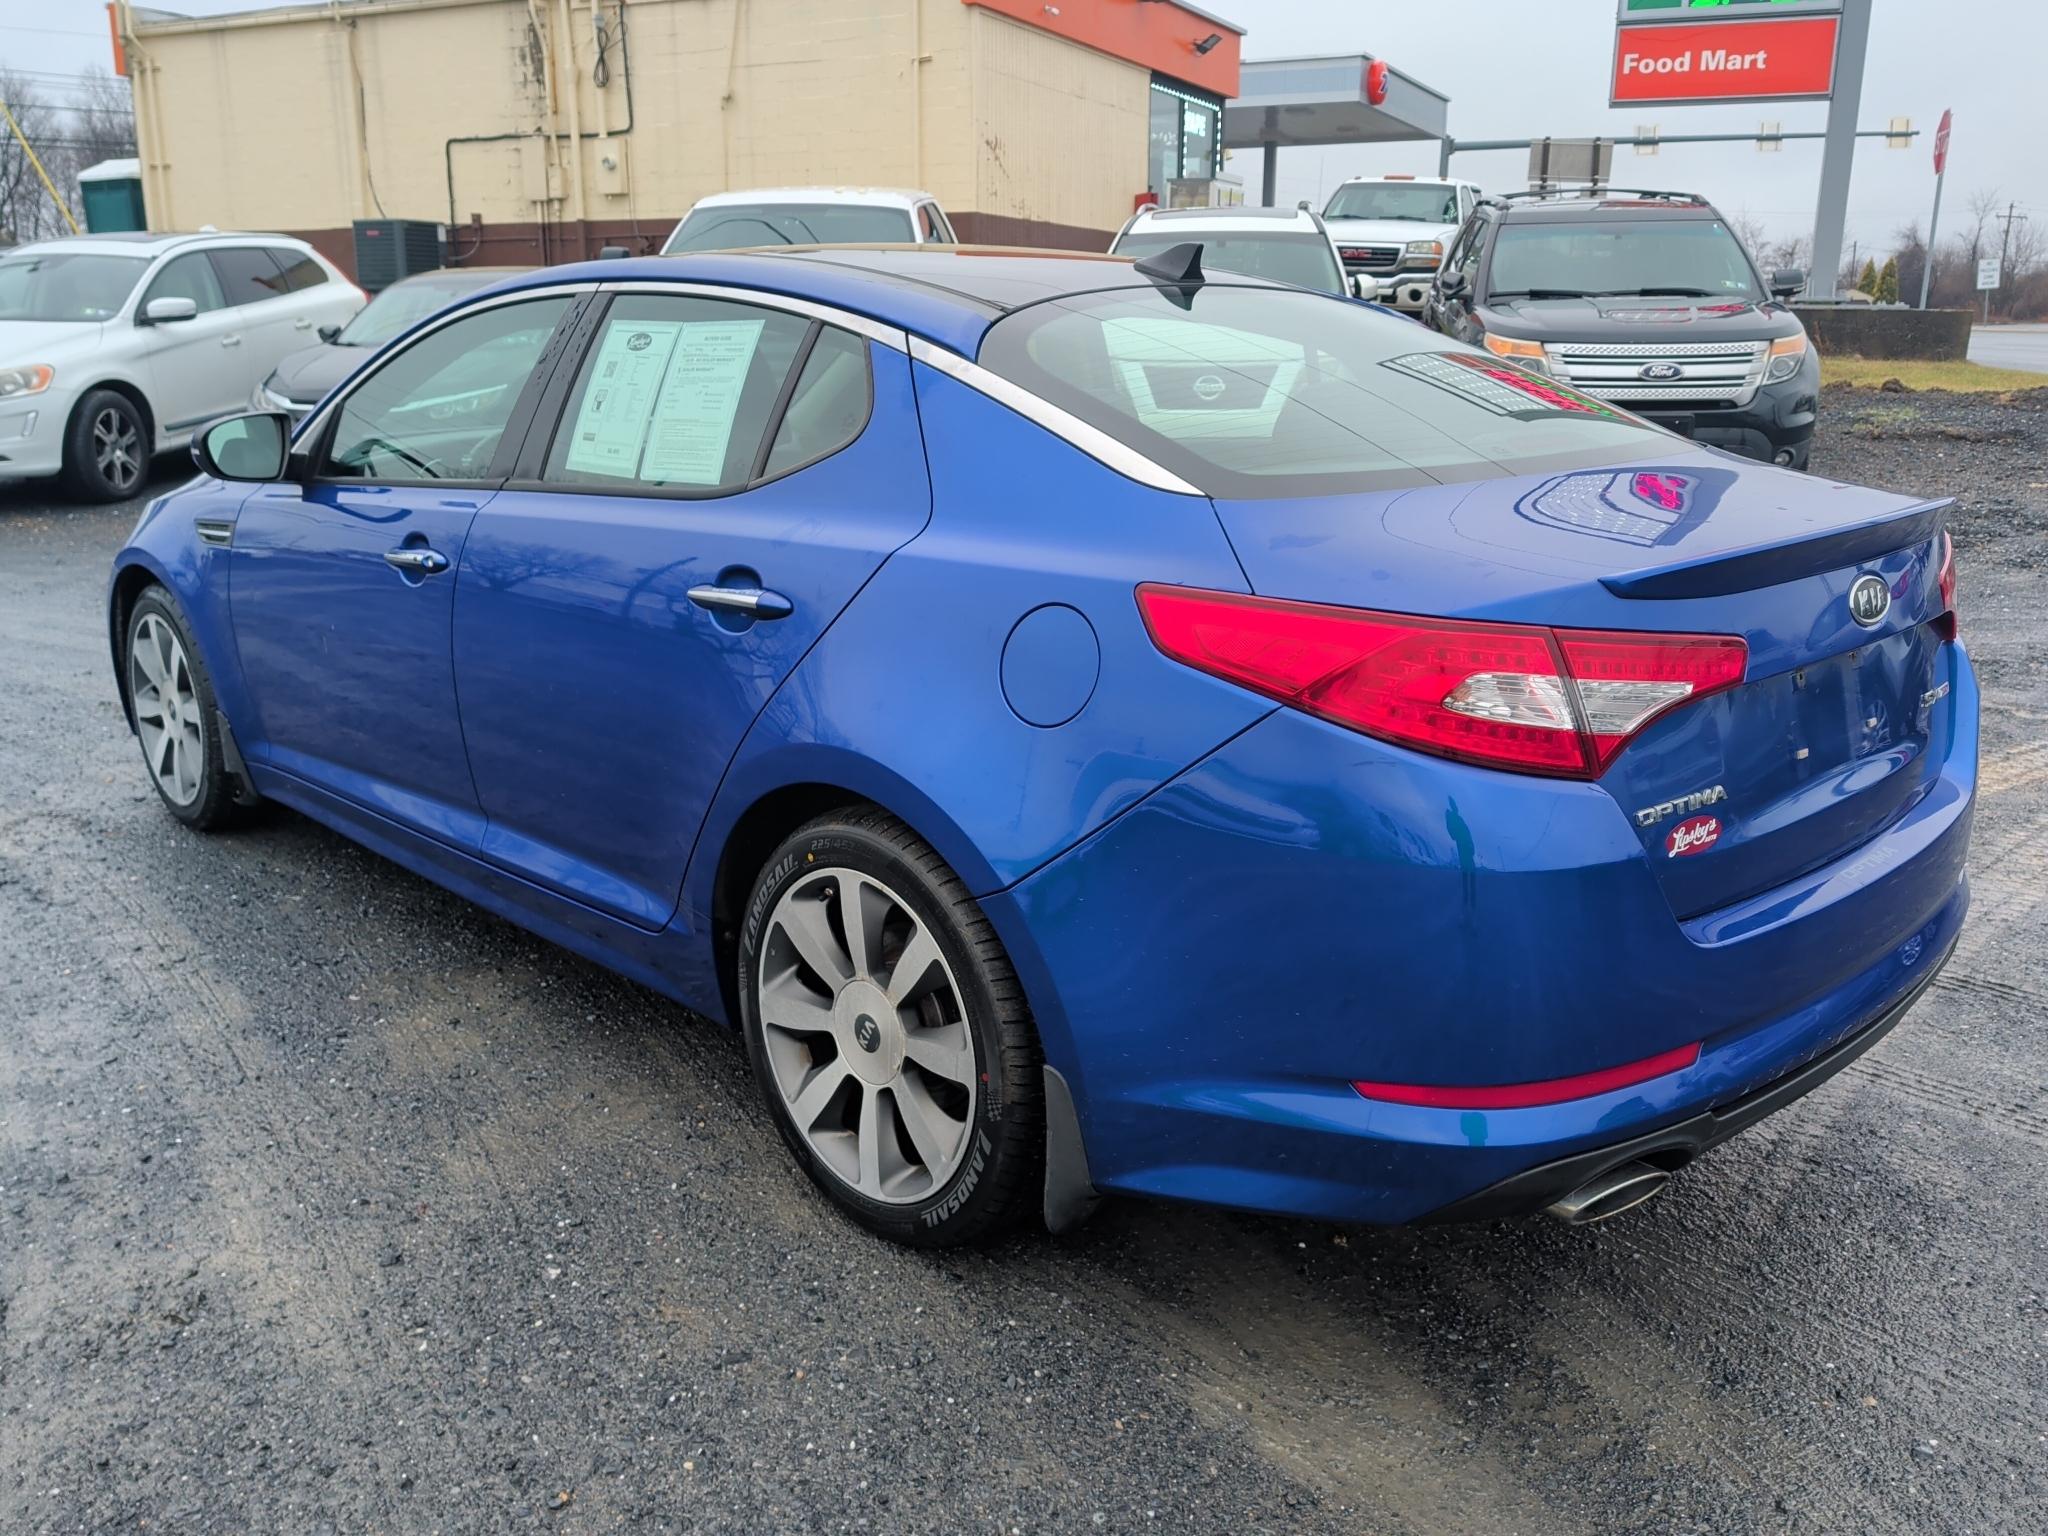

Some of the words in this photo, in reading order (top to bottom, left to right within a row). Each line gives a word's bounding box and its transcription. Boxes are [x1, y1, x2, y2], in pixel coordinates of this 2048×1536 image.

[1623, 51, 1691, 75] Food
[1700, 49, 1768, 72] Mart
[1648, 365, 1675, 377] Ford
[1633, 784, 1729, 827] OPTIMA
[1668, 818, 1718, 858] Lipsky's
[744, 853, 799, 957] LANDSAIL
[920, 1127, 992, 1228] LANDSAIL
